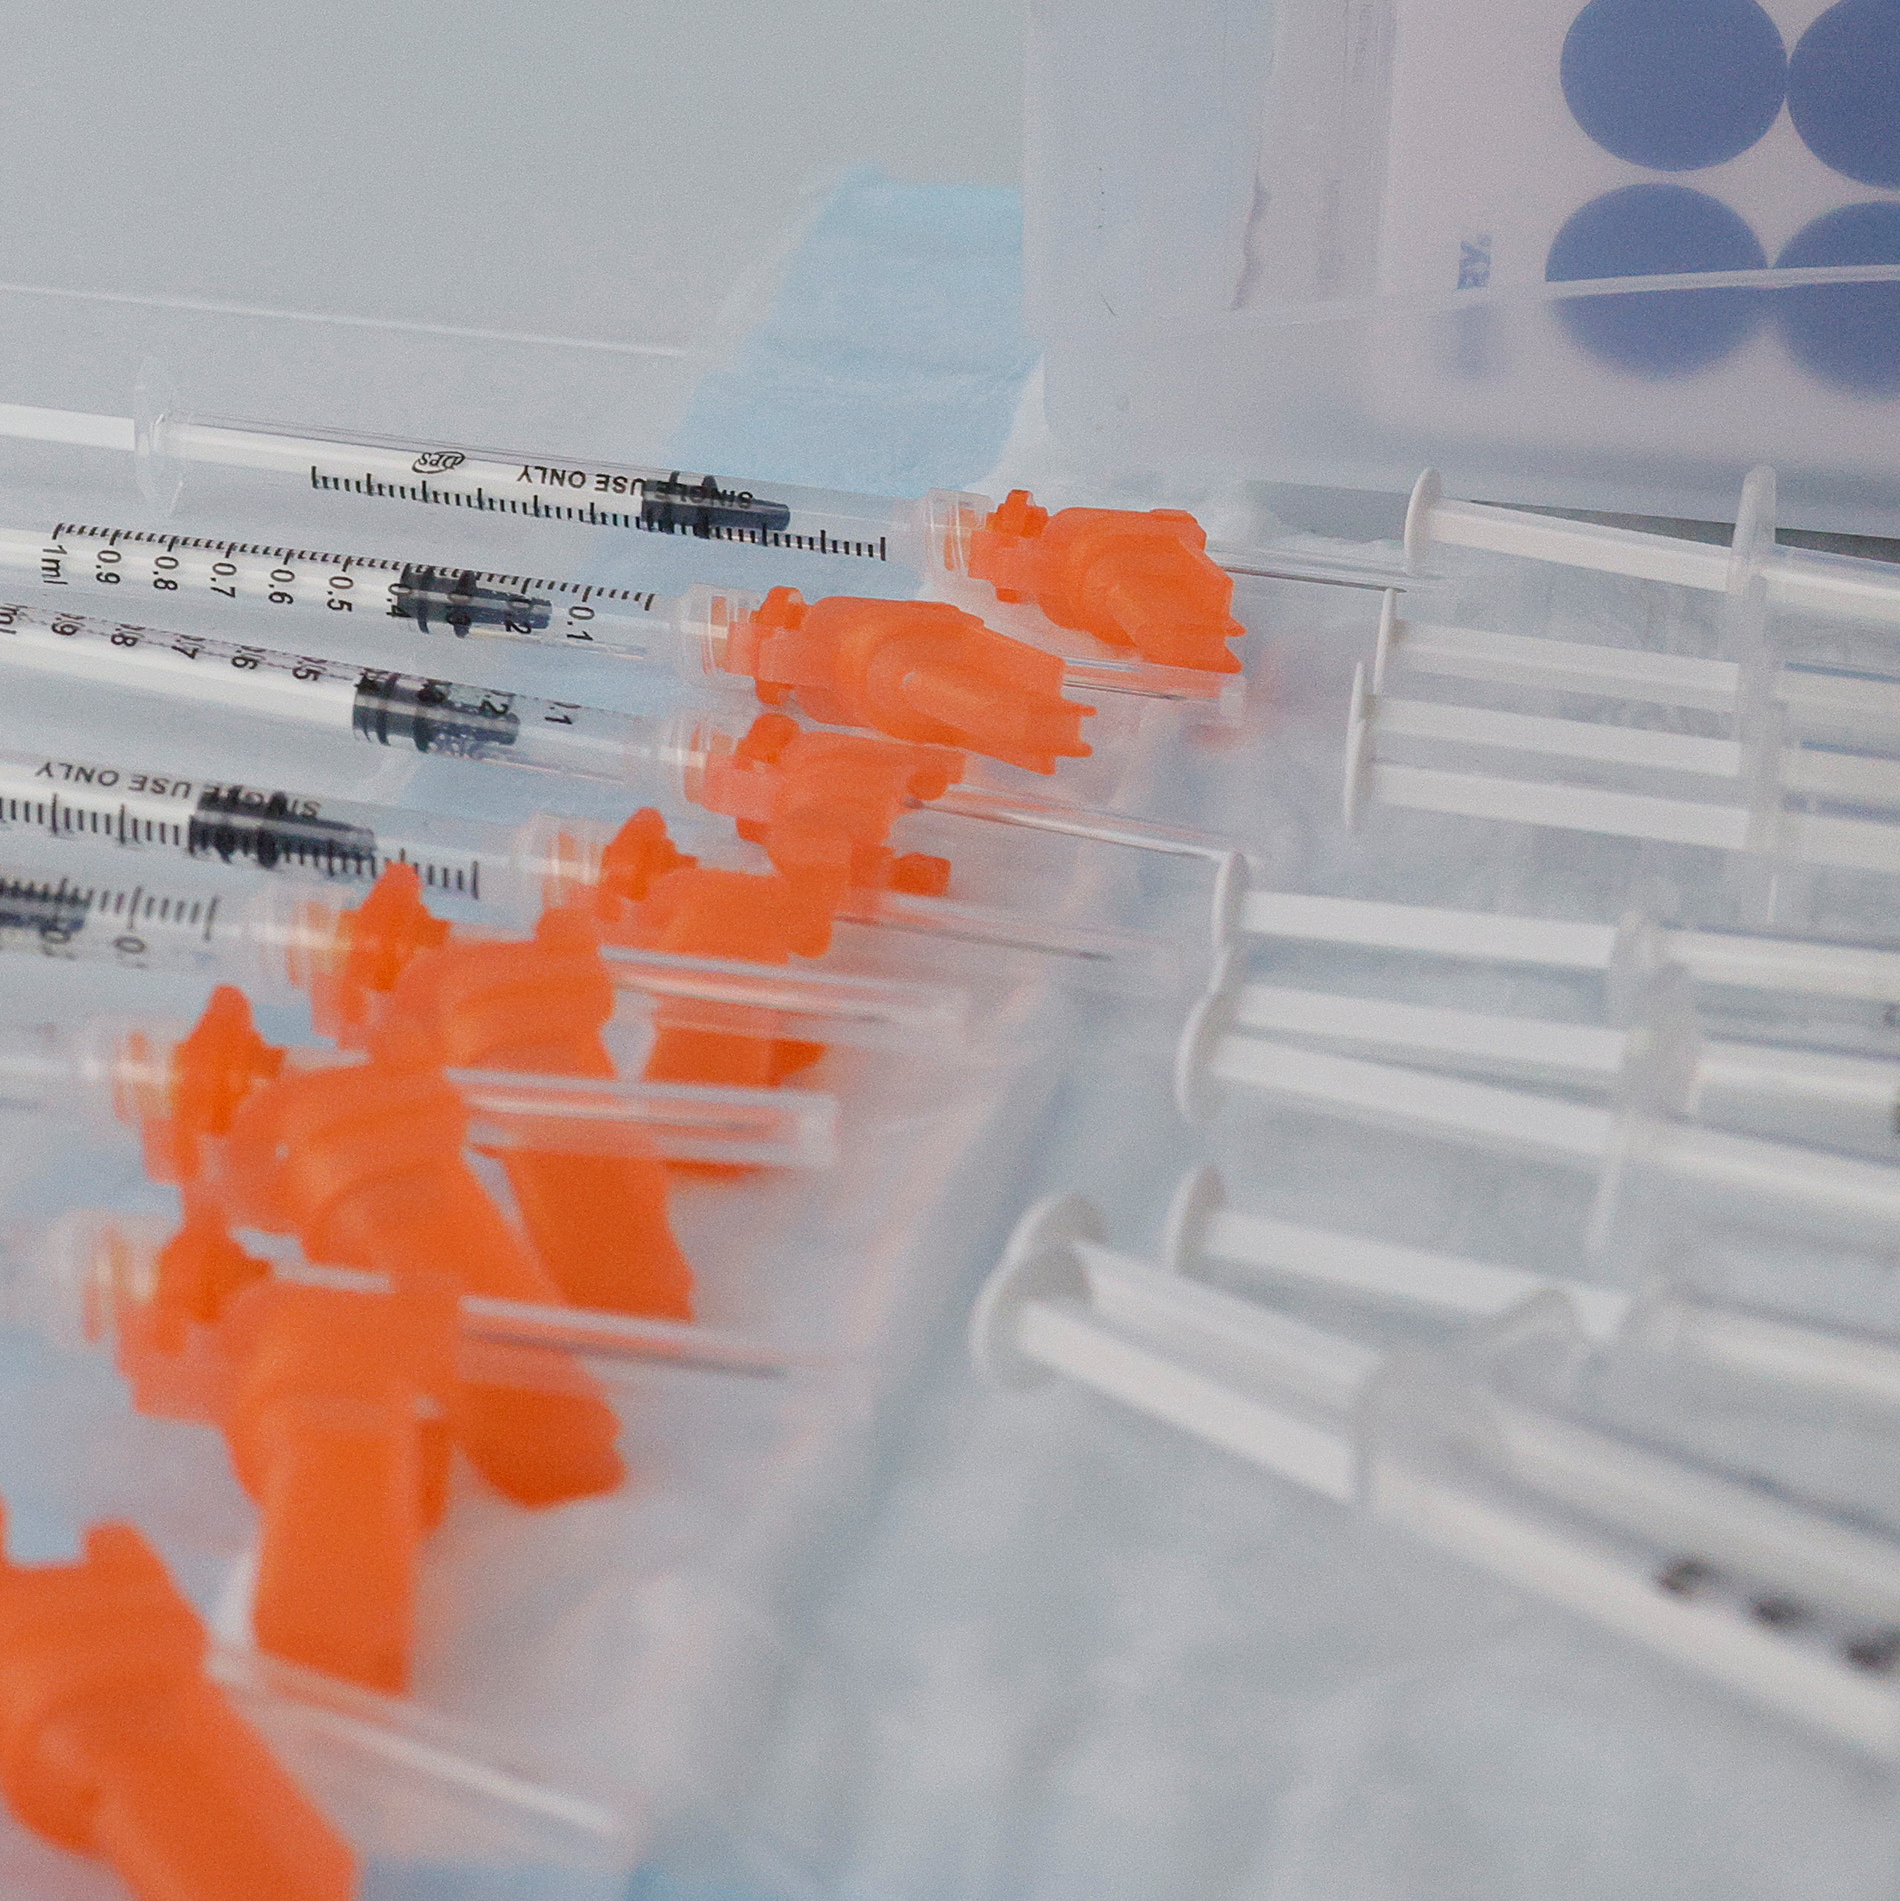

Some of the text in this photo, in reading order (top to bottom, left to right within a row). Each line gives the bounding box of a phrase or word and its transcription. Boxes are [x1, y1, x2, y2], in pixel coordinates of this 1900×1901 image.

[516, 463, 588, 490] ONLY
[595, 472, 644, 497] USE
[41, 544, 68, 586] 1ml
[96, 549, 122, 585] 0.9
[152, 555, 179, 591] 0.8
[210, 562, 237, 599] 0.7
[268, 568, 296, 605] 0.6
[326, 575, 354, 612] 0.5
[385, 582, 413, 619] 0.4
[566, 604, 595, 642] 0.1
[35, 759, 120, 787] ONLY
[128, 772, 193, 799] USE
